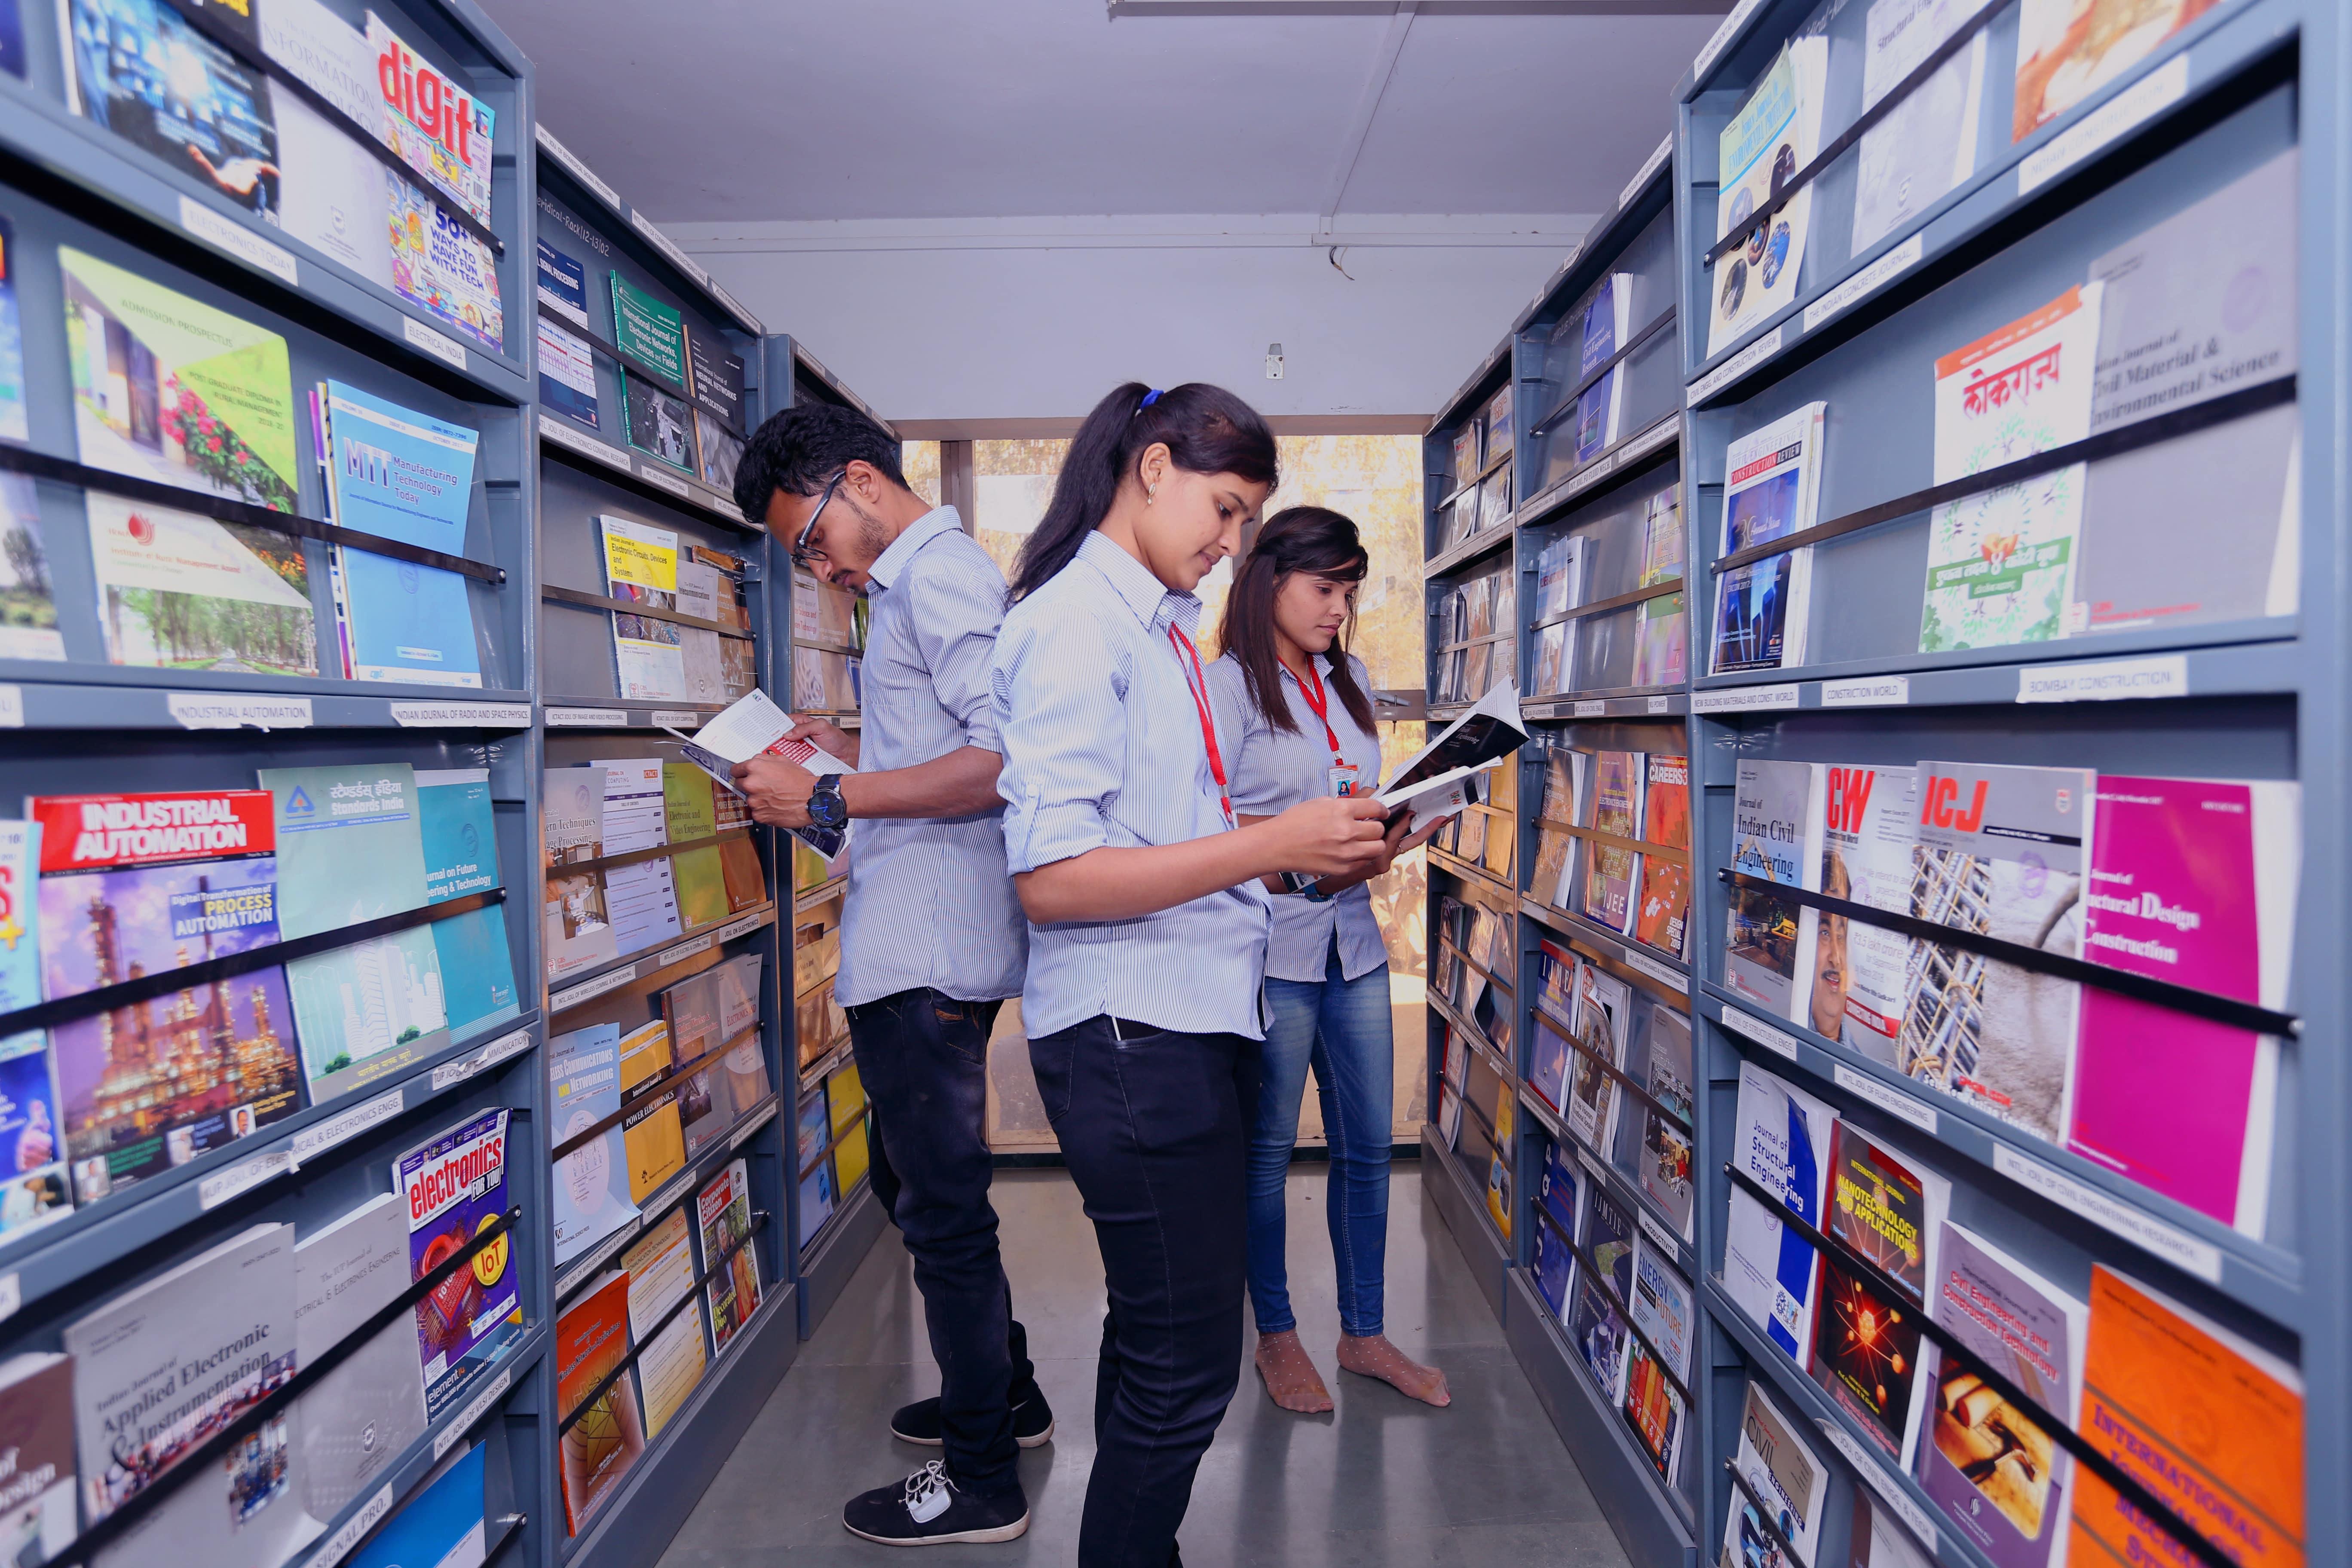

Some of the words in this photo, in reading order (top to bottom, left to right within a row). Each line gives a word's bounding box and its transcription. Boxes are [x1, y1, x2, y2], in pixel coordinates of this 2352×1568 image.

[1877, 12, 1915, 54] Structural
[379, 42, 472, 168] digit
[190, 211, 262, 259] ELECTRONICS
[264, 248, 291, 273] TODAY
[431, 226, 460, 254] WAYS
[462, 246, 475, 264] TO
[432, 241, 457, 265] HAVE
[459, 257, 477, 276] FUN
[429, 250, 458, 276] WITH
[458, 267, 484, 291] TECH
[1810, 304, 1821, 321] THE
[1823, 291, 1842, 312] INDIAN
[1844, 270, 1877, 299] CONCRETE
[122, 300, 175, 326] ADMISSION
[178, 319, 233, 347] PROSPECTUS
[622, 305, 650, 330] International
[651, 321, 670, 341] Journal
[671, 332, 676, 345] of
[629, 322, 652, 345] Electronic
[652, 335, 677, 359] Networks,
[409, 327, 443, 351] ELECTRICAL
[446, 345, 461, 360] INDIA
[636, 339, 653, 358] Devices
[661, 352, 677, 370] Fields
[1690, 388, 1700, 399] CIVIL
[1700, 380, 1712, 395] ENGG.
[1713, 374, 1721, 384] AND
[1723, 350, 1756, 378] CONSTRUCTION
[1758, 335, 1778, 353] REVIEW.
[1963, 342, 2063, 420] लोकराज्य
[696, 370, 713, 389] NEURAL
[714, 380, 736, 401] NETWORKS
[698, 382, 707, 394] AND
[699, 393, 728, 417] APPLICATIONS
[343, 436, 392, 489] MTT
[394, 456, 458, 486] Manufacturing
[1731, 454, 1776, 485] CONSTRUCTION
[1777, 444, 1801, 465] REVIEW
[394, 472, 442, 496] Technology
[395, 487, 419, 506] Today
[612, 544, 634, 557] Electronic
[634, 549, 650, 560] Circuits,
[650, 553, 667, 564] Devices
[613, 556, 622, 564] and
[615, 567, 633, 579] Systems
[679, 587, 710, 600] Telecommunications
[2030, 678, 2073, 692] BOMBAY
[2078, 671, 2168, 689] CONSTRUCTION
[177, 707, 239, 718] INDUSTRIAL
[395, 711, 420, 720] INDIAN
[423, 711, 449, 720] JOURNAL
[451, 711, 459, 720] OF
[461, 711, 478, 719] RADIO
[479, 711, 490, 719] AND
[491, 711, 507, 719] SPACE
[1695, 698, 1703, 707] NEW
[1704, 697, 1722, 706] BUILDING
[1723, 695, 1746, 705] MATERIALS
[1747, 695, 1757, 703] AND
[1758, 693, 1774, 702] CONST.
[82, 799, 239, 830] INDUSTRIAL
[331, 798, 379, 815] Standards
[381, 796, 404, 811] India
[1738, 796, 1756, 809] Journal
[1757, 799, 1763, 810] of
[1827, 767, 1875, 834] CW
[1920, 775, 1989, 833] ICJ
[73, 824, 247, 862] AUTOMATION
[1738, 814, 1767, 839] Indian
[1770, 819, 1794, 844] Civil
[1736, 843, 1794, 882] Engineering
[172, 893, 201, 905] Digital
[202, 886, 260, 902] Transformation
[262, 885, 271, 896] of
[205, 893, 273, 916] PROCESS
[1603, 890, 1625, 915] IJEE
[175, 907, 273, 937] AUTOMATION
[1666, 925, 1682, 940] SPECIAL
[1669, 916, 1684, 931] DESIGN
[1671, 936, 1681, 950] 2018
[566, 993, 574, 1001] JOU.
[581, 985, 595, 995] WIRELESS
[596, 980, 609, 990] COMMU.
[613, 971, 631, 983] NETWORKING.
[1542, 954, 1570, 994] IJME
[564, 1046, 613, 1077] COMMUNICATIONS
[558, 1082, 569, 1098] AND
[570, 1066, 613, 1094] NETWORKING
[626, 1109, 643, 1127] POWER
[645, 1090, 674, 1116] ELECTRONICS
[1753, 1120, 1778, 1145] Journal
[1780, 1136, 1787, 1152] of
[1579, 1149, 1594, 1171] NUCLEAR
[1594, 1164, 1605, 1180] INDIA
[1752, 1136, 1795, 1180] Structural
[410, 1136, 502, 1221] electronics
[472, 1176, 484, 1197] FOR
[487, 1169, 498, 1190] YOU
[701, 1178, 729, 1209] Corporate
[1751, 1156, 1804, 1212] Engineering
[1851, 1160, 1884, 1189] INTERNATIONAL
[1885, 1183, 1905, 1204] JOURNAL
[1874, 1186, 1880, 1196] OF
[702, 1197, 722, 1222] Citizen
[1836, 1190, 1853, 1216] AND
[1854, 1201, 1917, 1259] APPLICATIONS
[1838, 1173, 1918, 1243] NANOTECHNOLOGY
[1645, 1220, 1675, 1256] PRODUCTIVITY
[481, 1240, 500, 1277] IoT
[1638, 1251, 1668, 1304] ENERGY
[1961, 1263, 2001, 1299] International
[2003, 1291, 2028, 1317] Journal
[2029, 1309, 2037, 1323] of
[714, 1292, 736, 1317] Decorated
[1657, 1295, 1681, 1341] FUTURE
[1951, 1271, 1970, 1298] Civil
[1971, 1284, 2029, 1339] Engineering
[2030, 1325, 2049, 1353] and
[715, 1315, 726, 1332] Duo
[1943, 1284, 2000, 1341] Construction
[2001, 1326, 2057, 1382] Technology
[103, 1377, 176, 1443] Applied
[181, 1323, 268, 1393] Electronic
[138, 1351, 269, 1440] Instrumentation
[428, 1365, 465, 1403] element14
[436, 1433, 449, 1454] INTL.
[452, 1417, 466, 1439] JOU.
[467, 1407, 475, 1424] OF
[476, 1395, 487, 1415] VLSI
[488, 1375, 508, 1404] DESIGN
[1747, 1415, 1774, 1468] CIVIL
[2094, 1403, 2265, 1553] INTERNATIONAL
[1767, 1470, 1803, 1527] ENGINEERING
